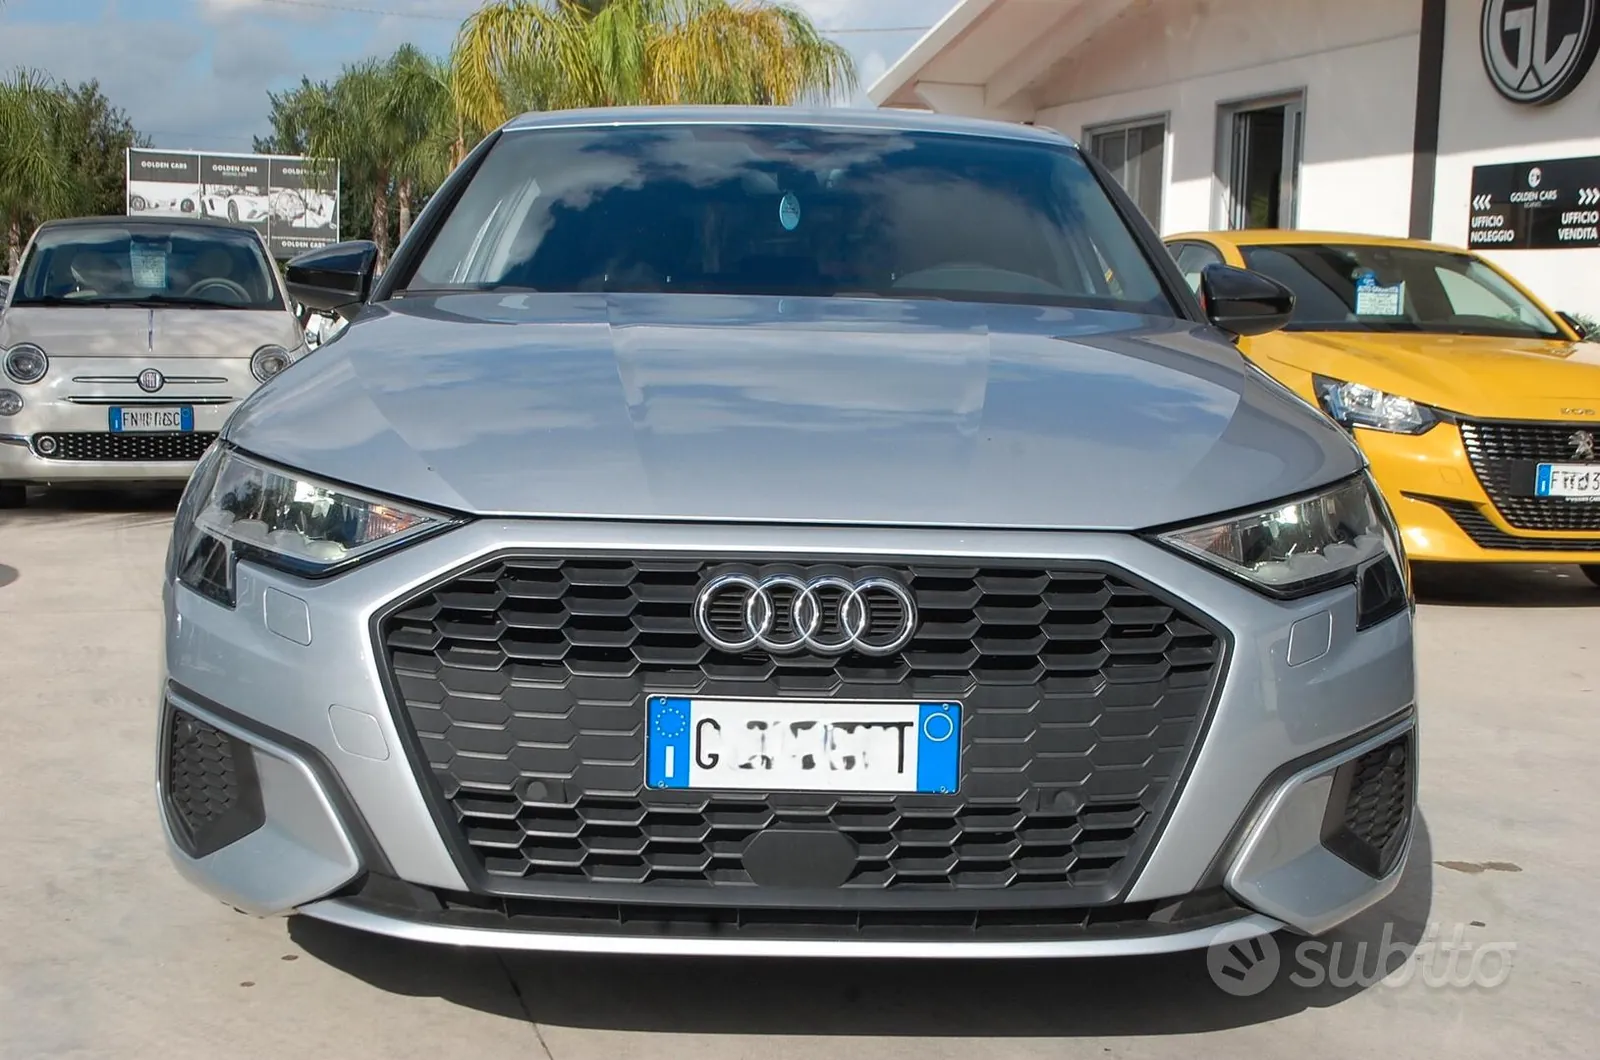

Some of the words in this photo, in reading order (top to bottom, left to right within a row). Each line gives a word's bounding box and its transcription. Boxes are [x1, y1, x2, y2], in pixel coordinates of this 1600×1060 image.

[212, 164, 240, 172] GOLDEN
[1510, 191, 1538, 203] GOLDEN
[1539, 189, 1558, 201] CARS
[1471, 214, 1504, 228] UFFICIO
[1561, 211, 1599, 225] UFFICIO
[1470, 229, 1515, 243] NOLEGGIO
[1558, 227, 1598, 241] VENDITA
